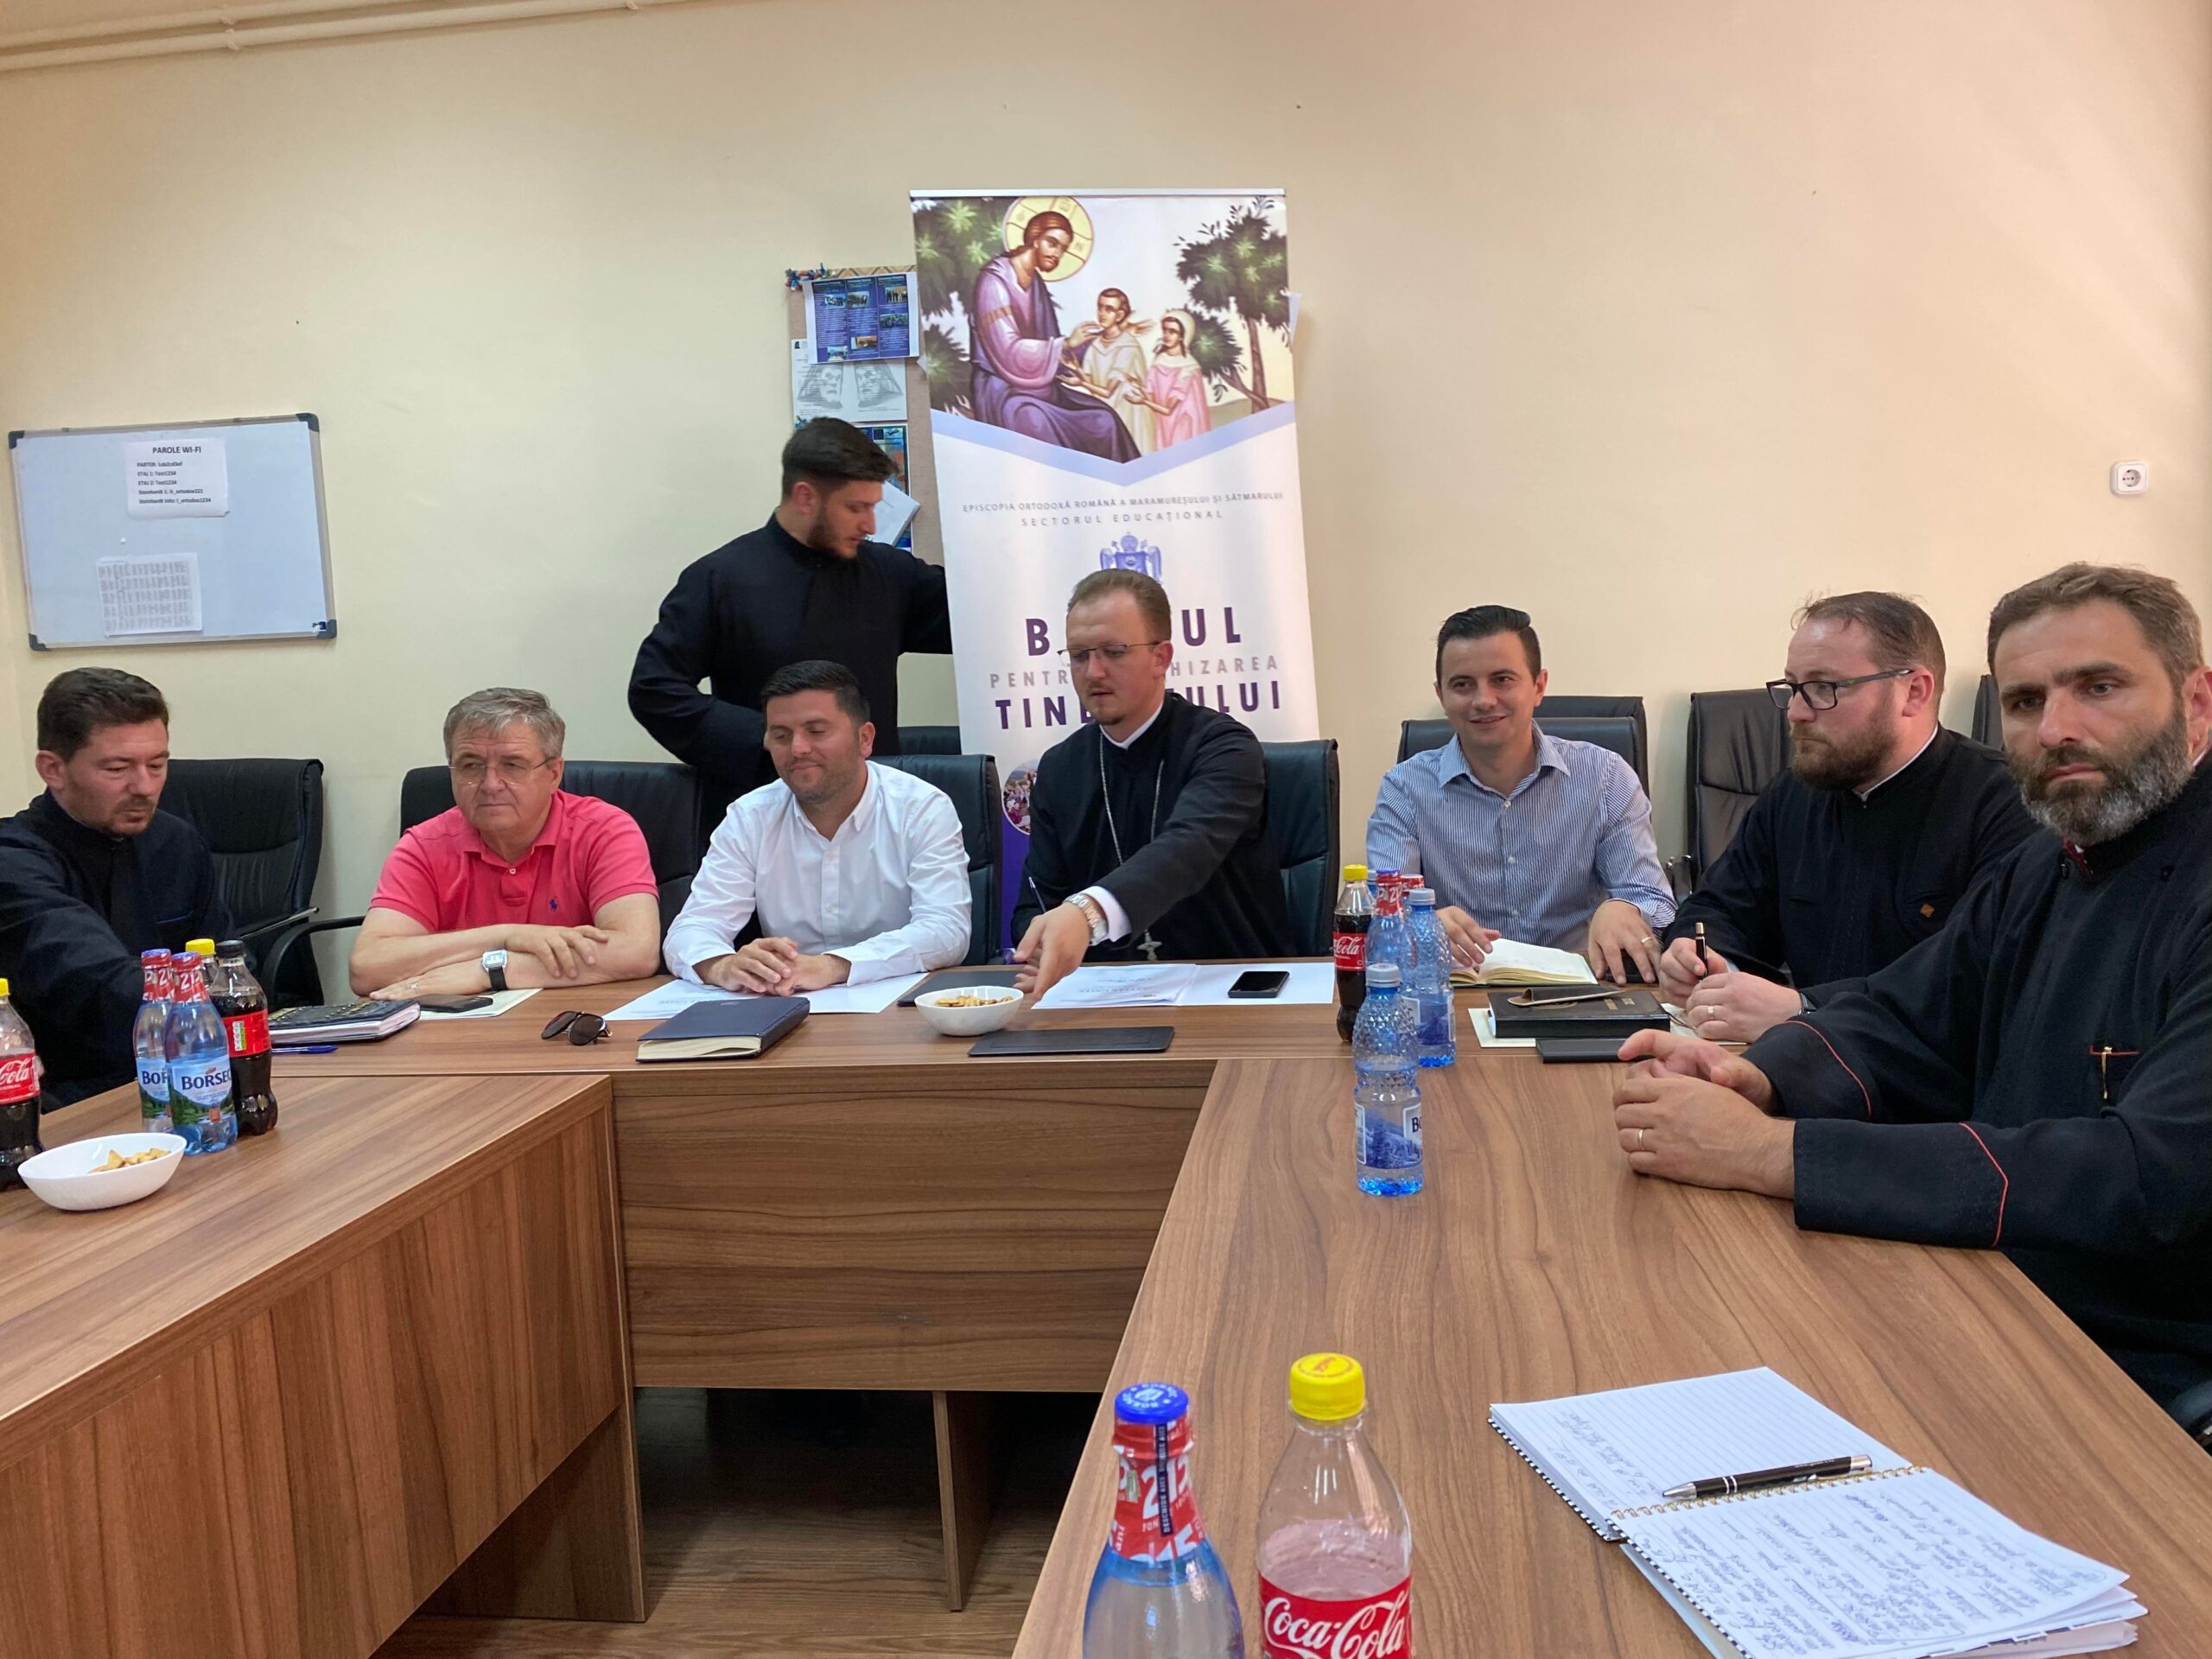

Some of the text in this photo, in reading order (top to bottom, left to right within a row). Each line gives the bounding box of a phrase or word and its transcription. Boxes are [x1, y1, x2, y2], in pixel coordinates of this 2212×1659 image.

[963, 503, 1015, 512] EPISCOPIA
[1021, 515, 1102, 526] SECTORUL
[1026, 607, 1241, 657] BUL
[990, 670, 1069, 689] PENTR
[1264, 1586, 1409, 1658] Coca-Cola
